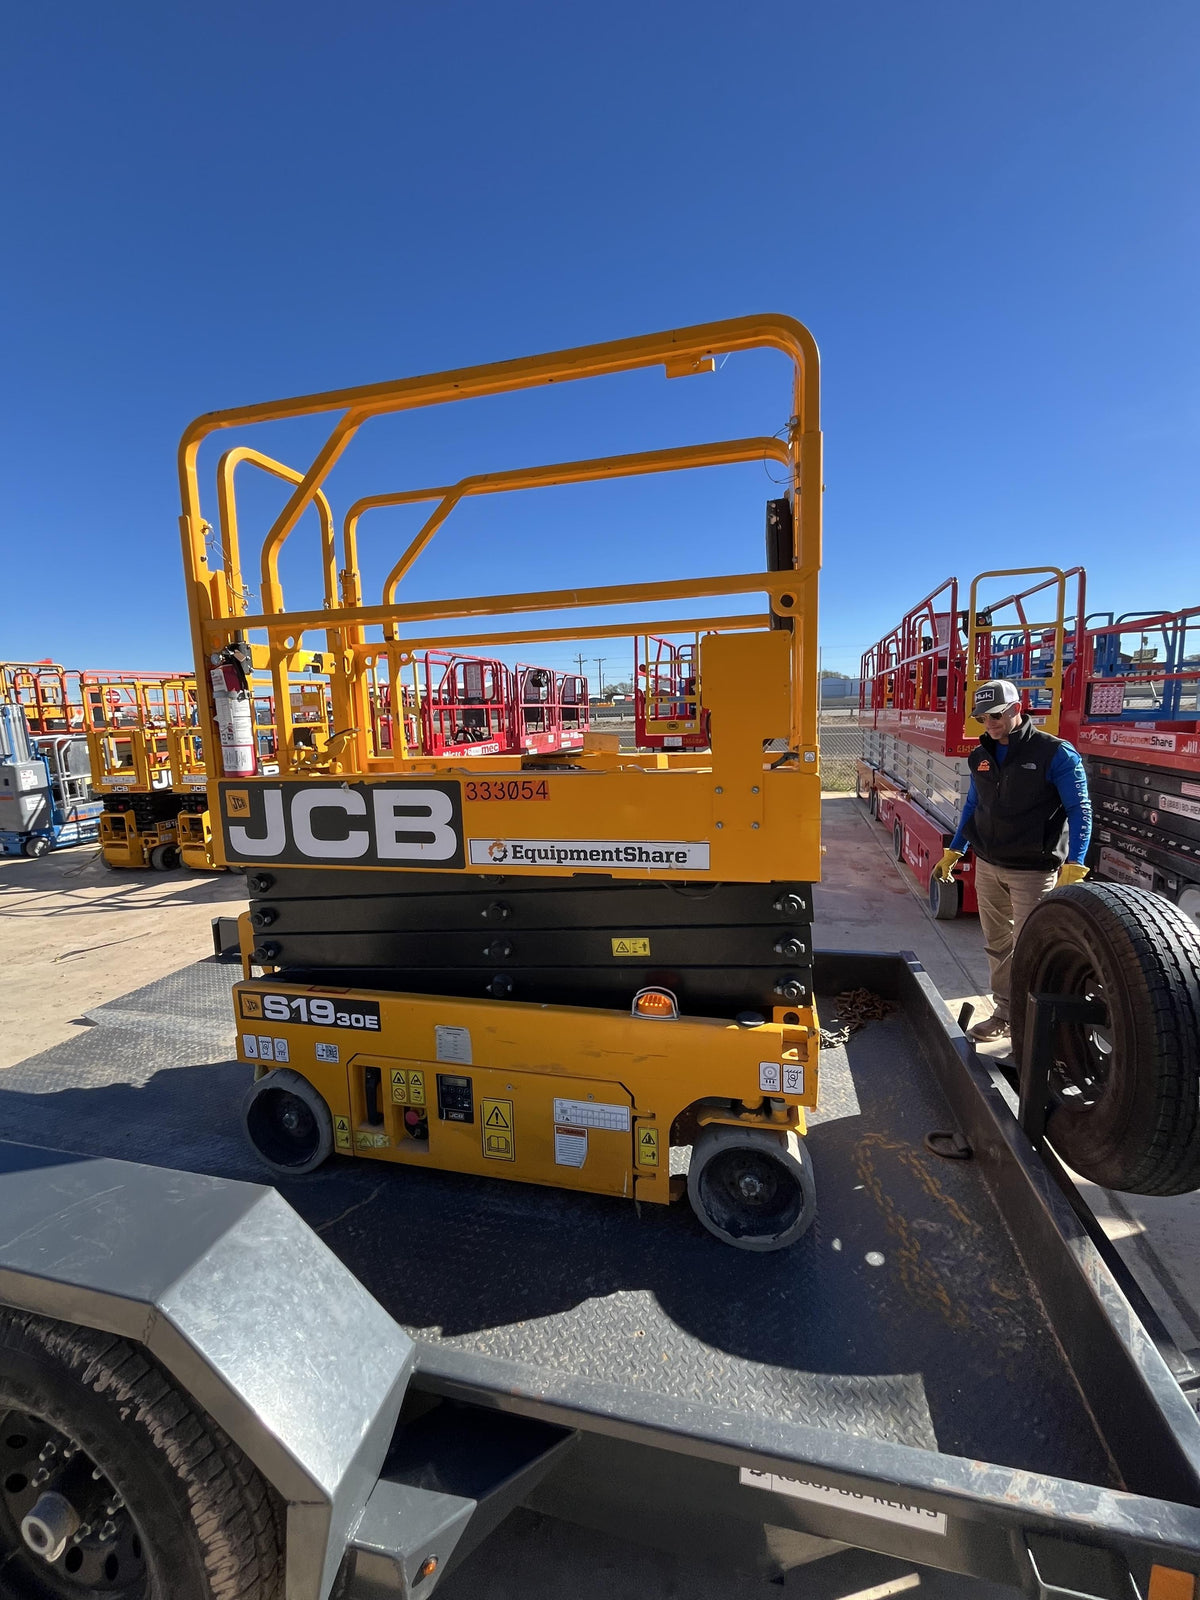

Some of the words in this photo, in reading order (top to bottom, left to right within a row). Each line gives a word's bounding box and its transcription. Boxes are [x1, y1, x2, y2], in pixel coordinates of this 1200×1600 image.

[466, 780, 549, 800] 333054
[229, 795, 248, 811] JCB
[229, 788, 457, 861] JCB
[511, 844, 688, 864] EquipmentShare
